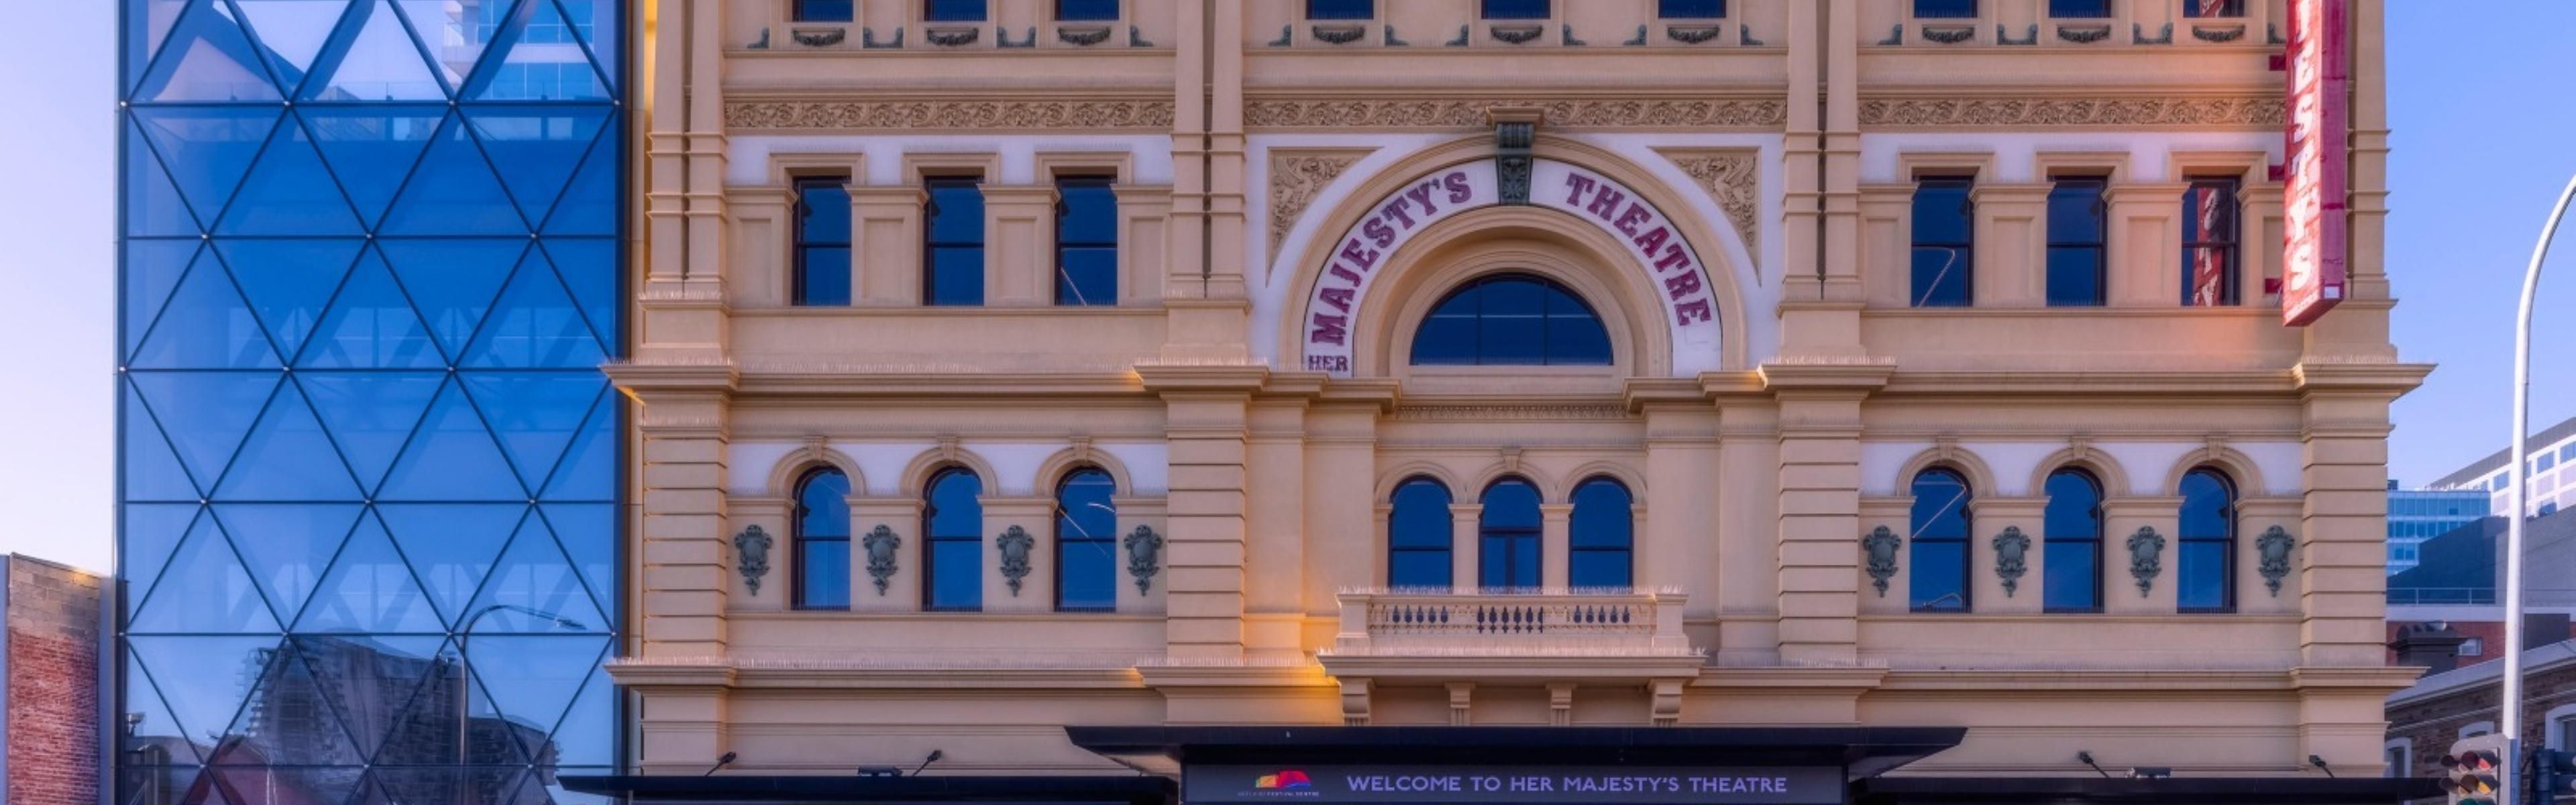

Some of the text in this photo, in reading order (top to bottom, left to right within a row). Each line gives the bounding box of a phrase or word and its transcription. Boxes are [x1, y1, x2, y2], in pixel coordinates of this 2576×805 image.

[1308, 172, 1713, 372] HER MAJESTY'S THEATRE
[1346, 775, 1788, 793] WELCOME TO HER MAJESTY'S THEATRE
